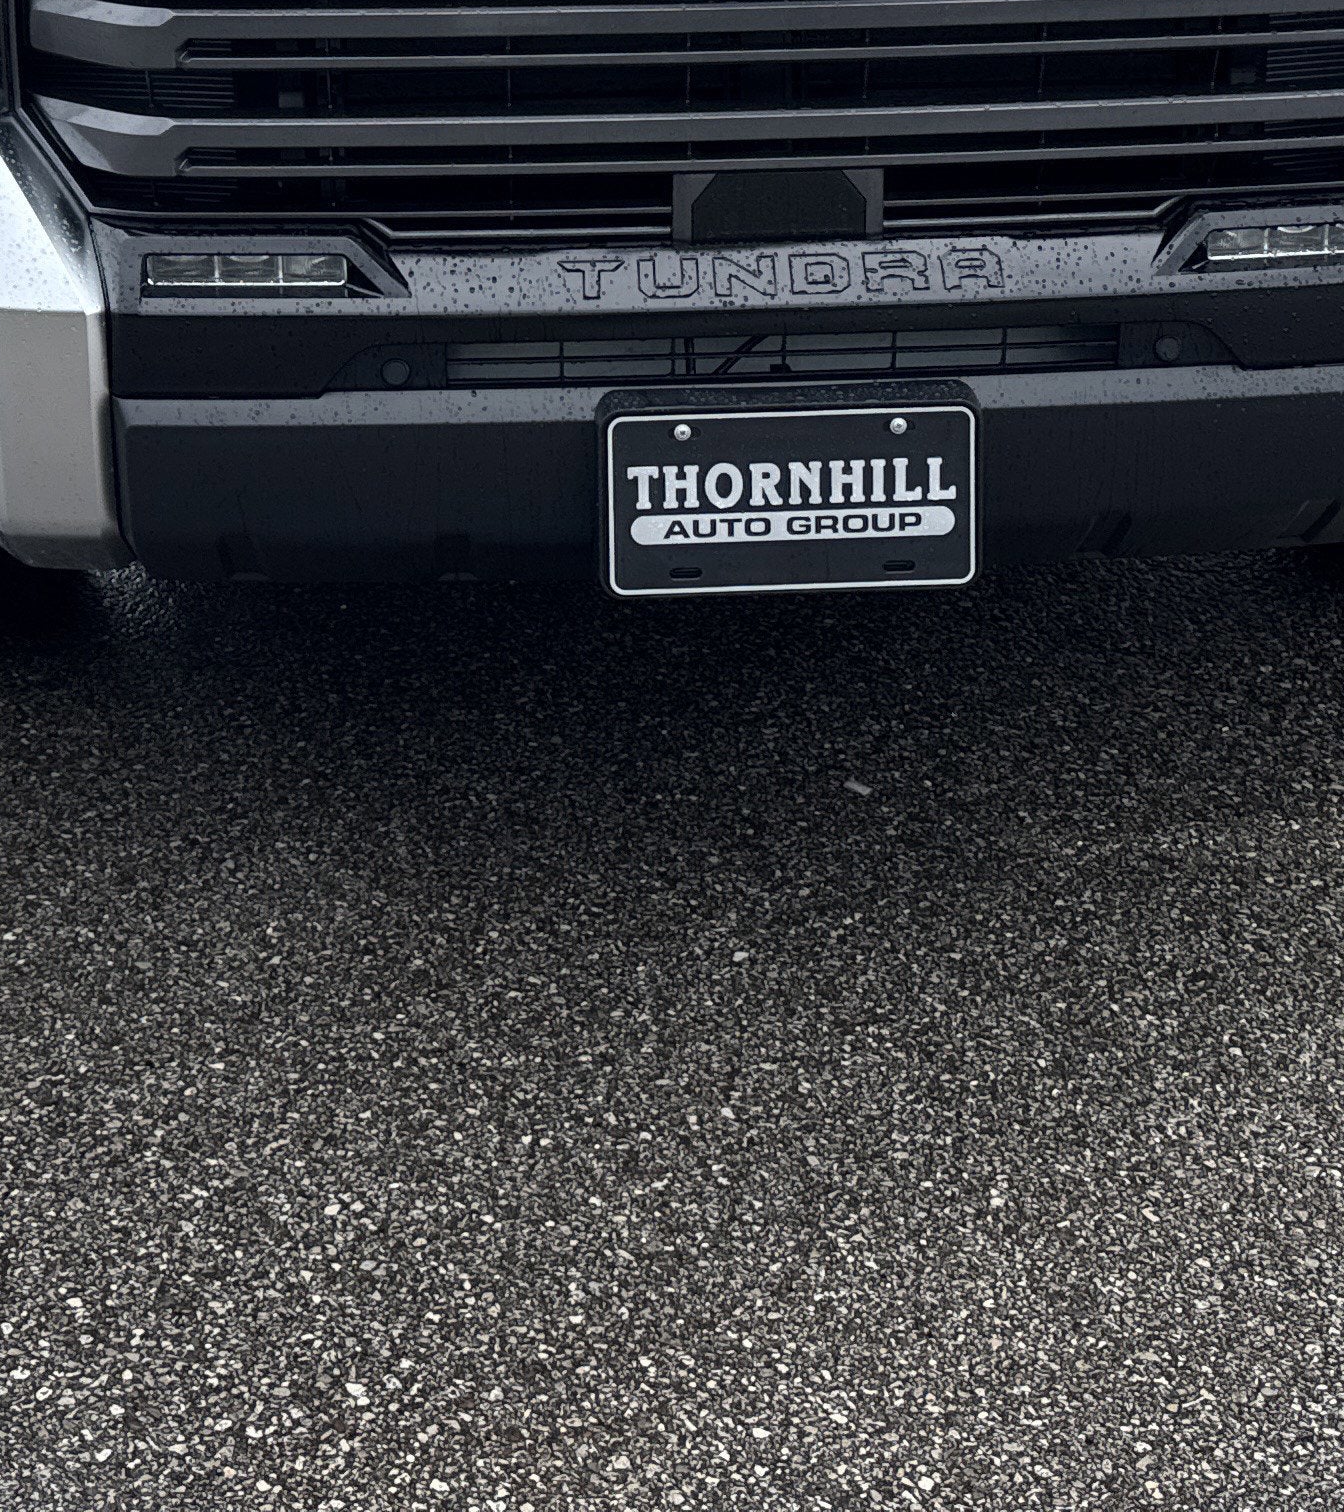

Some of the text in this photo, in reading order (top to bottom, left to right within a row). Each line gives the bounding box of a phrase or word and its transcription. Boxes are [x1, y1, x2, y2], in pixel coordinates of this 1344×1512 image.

[556, 248, 1006, 300] TUNDRA
[626, 456, 957, 511] THORNHILL
[663, 511, 923, 540] AUTO GROUP
